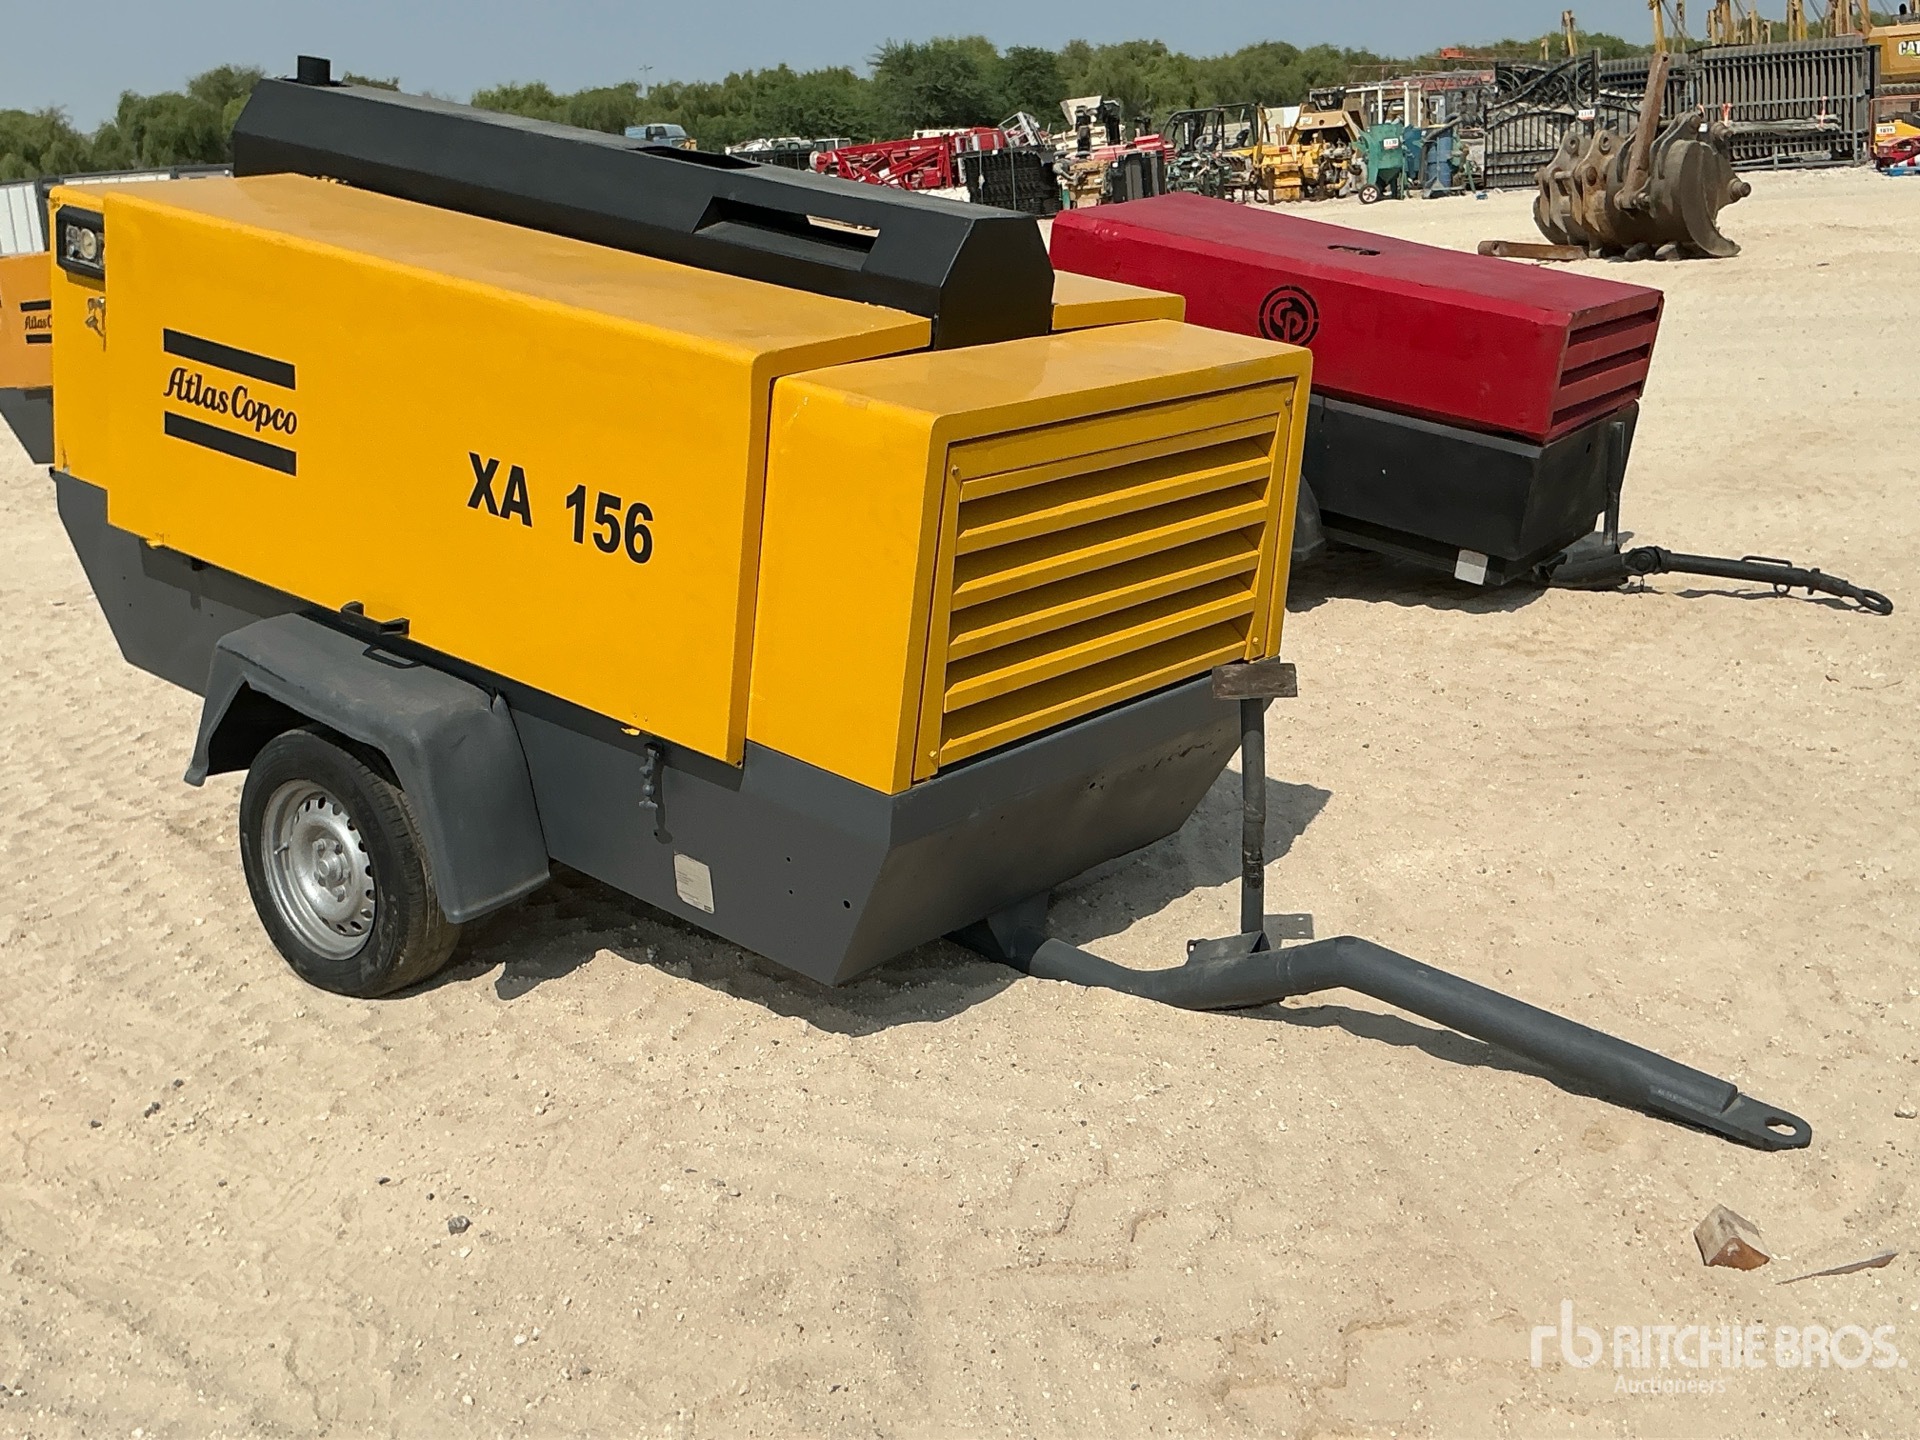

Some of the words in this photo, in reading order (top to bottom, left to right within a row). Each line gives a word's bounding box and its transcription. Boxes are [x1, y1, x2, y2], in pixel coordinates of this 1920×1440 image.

[1898, 41, 1920, 56] CAT
[25, 315, 47, 330] Atlas
[163, 367, 229, 414] Atlas
[231, 385, 297, 435] Copco
[467, 452, 533, 528] XA
[566, 484, 654, 564] 156
